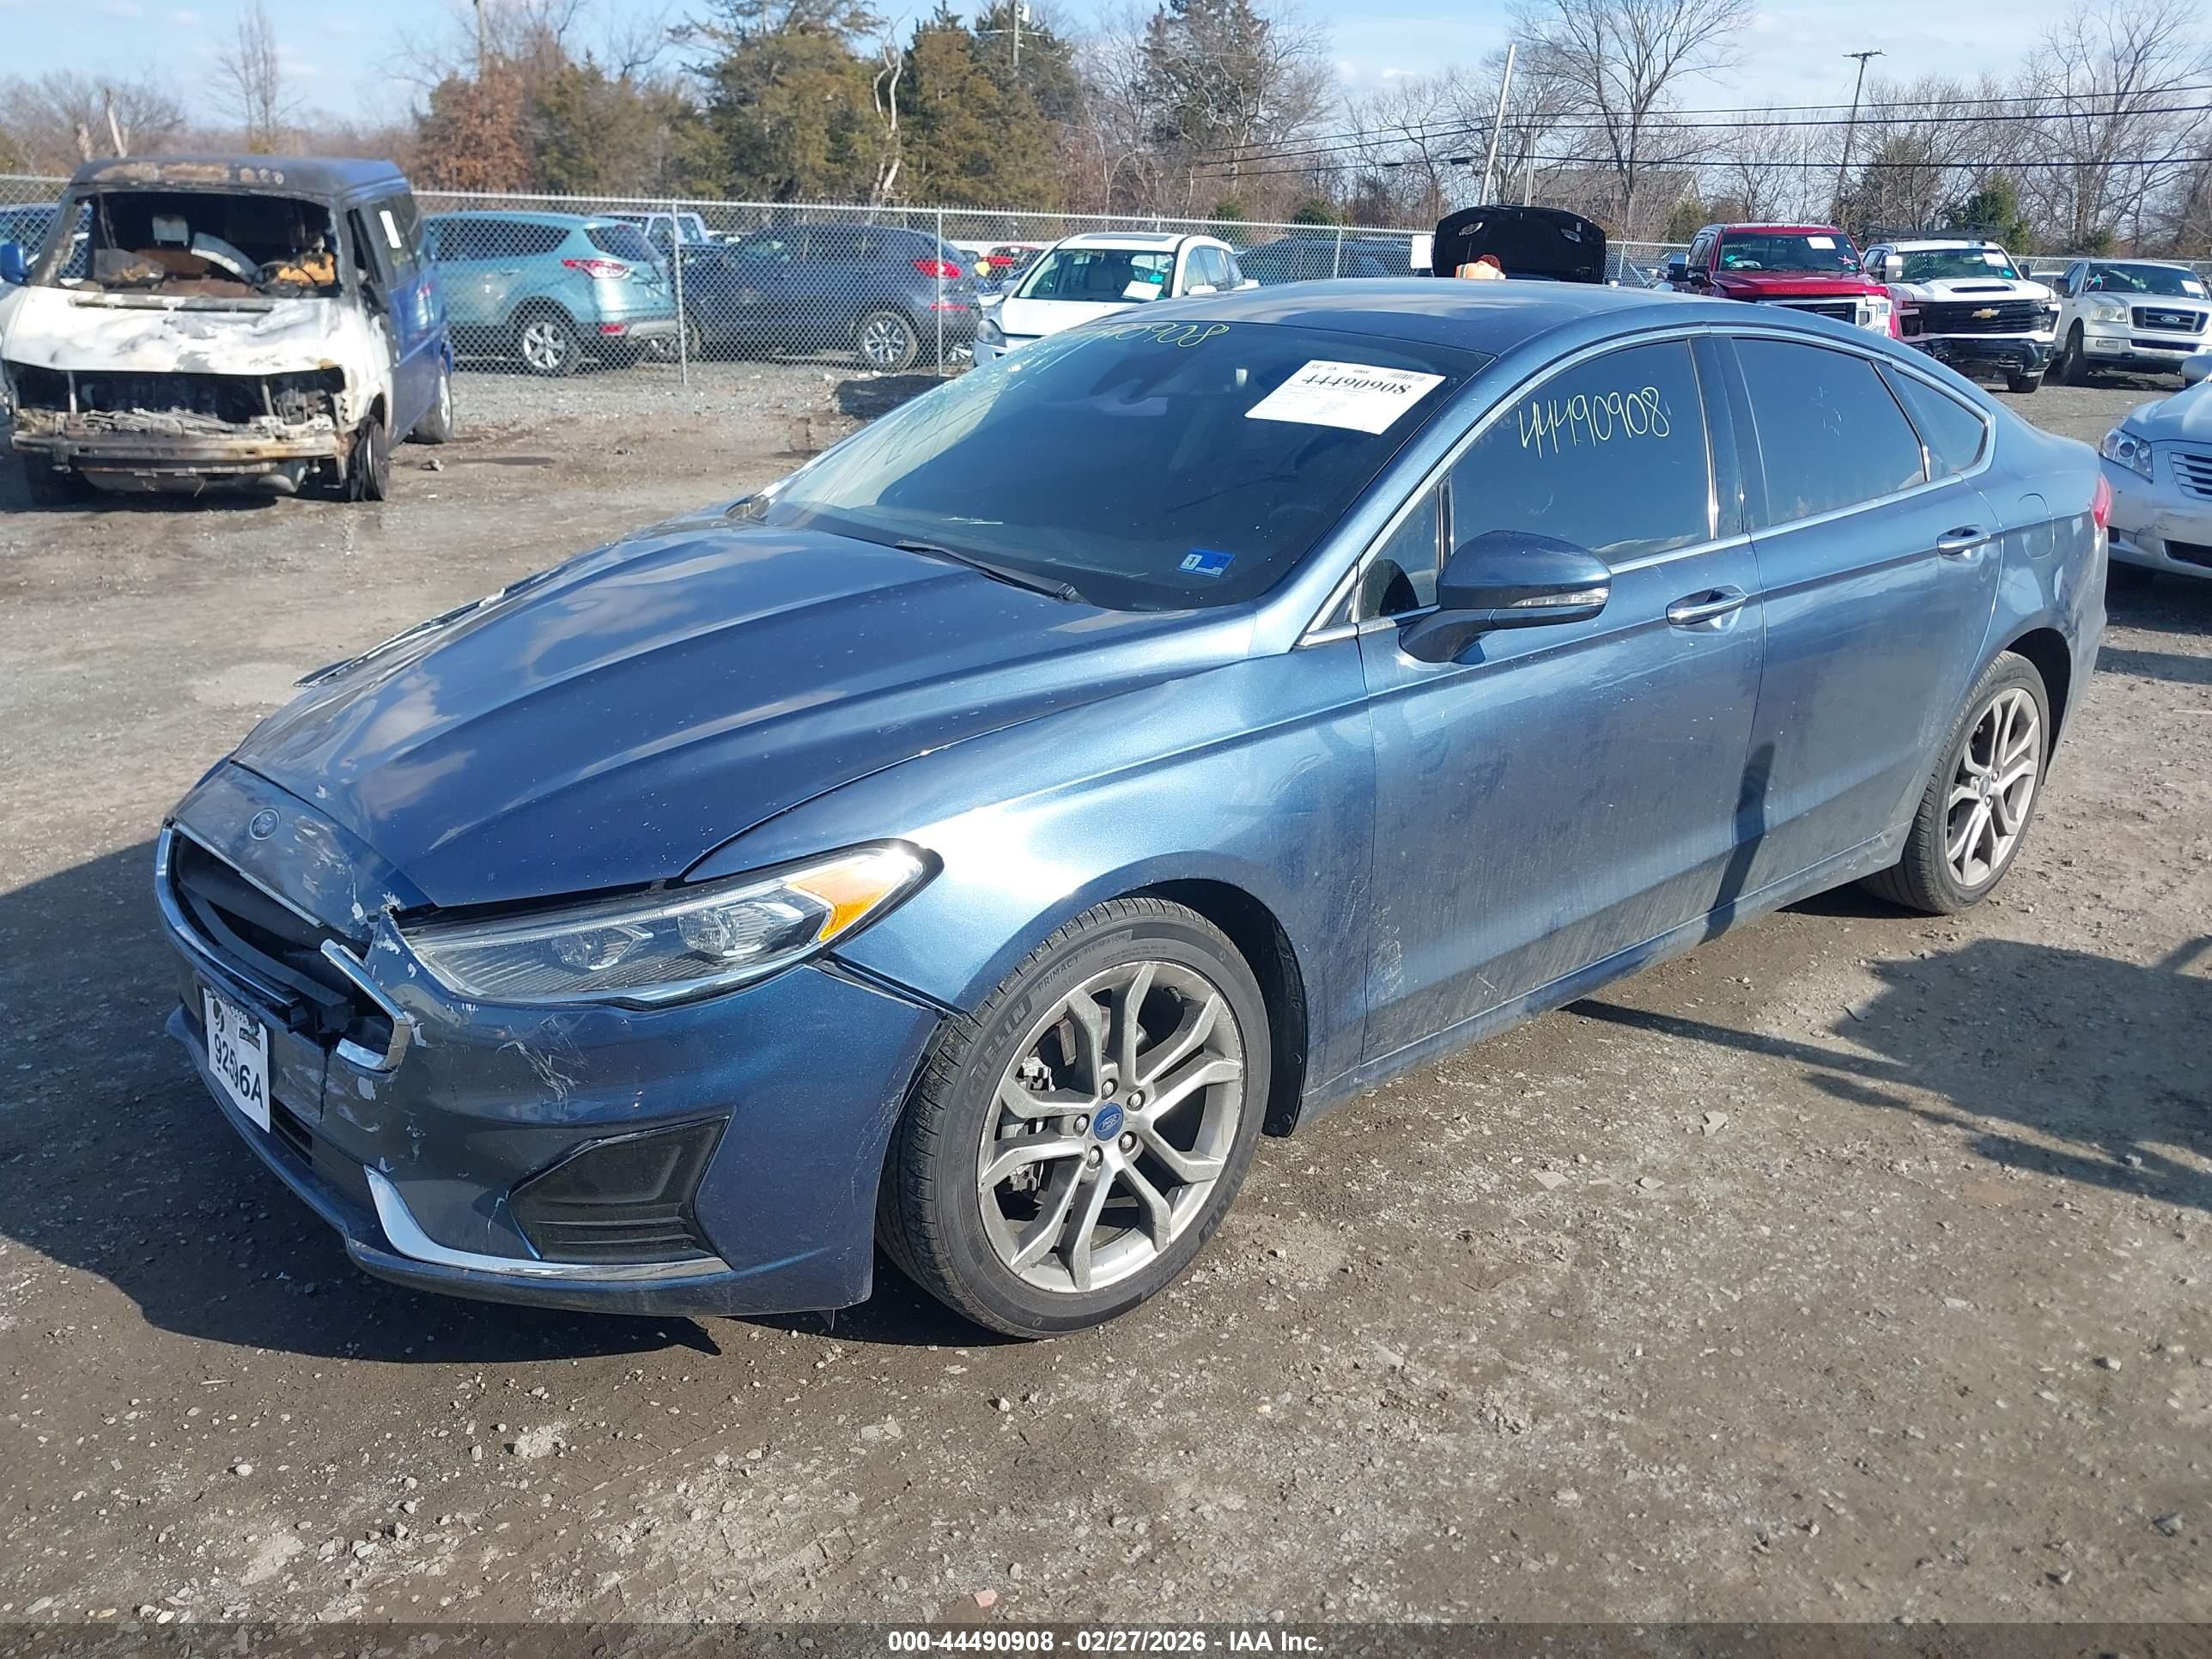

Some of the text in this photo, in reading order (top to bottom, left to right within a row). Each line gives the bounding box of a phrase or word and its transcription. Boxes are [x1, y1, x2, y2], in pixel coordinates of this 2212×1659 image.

[1302, 374, 1413, 395] 44490908
[1518, 386, 1670, 460] 44490908
[1038, 953, 1079, 993] PRIMACY
